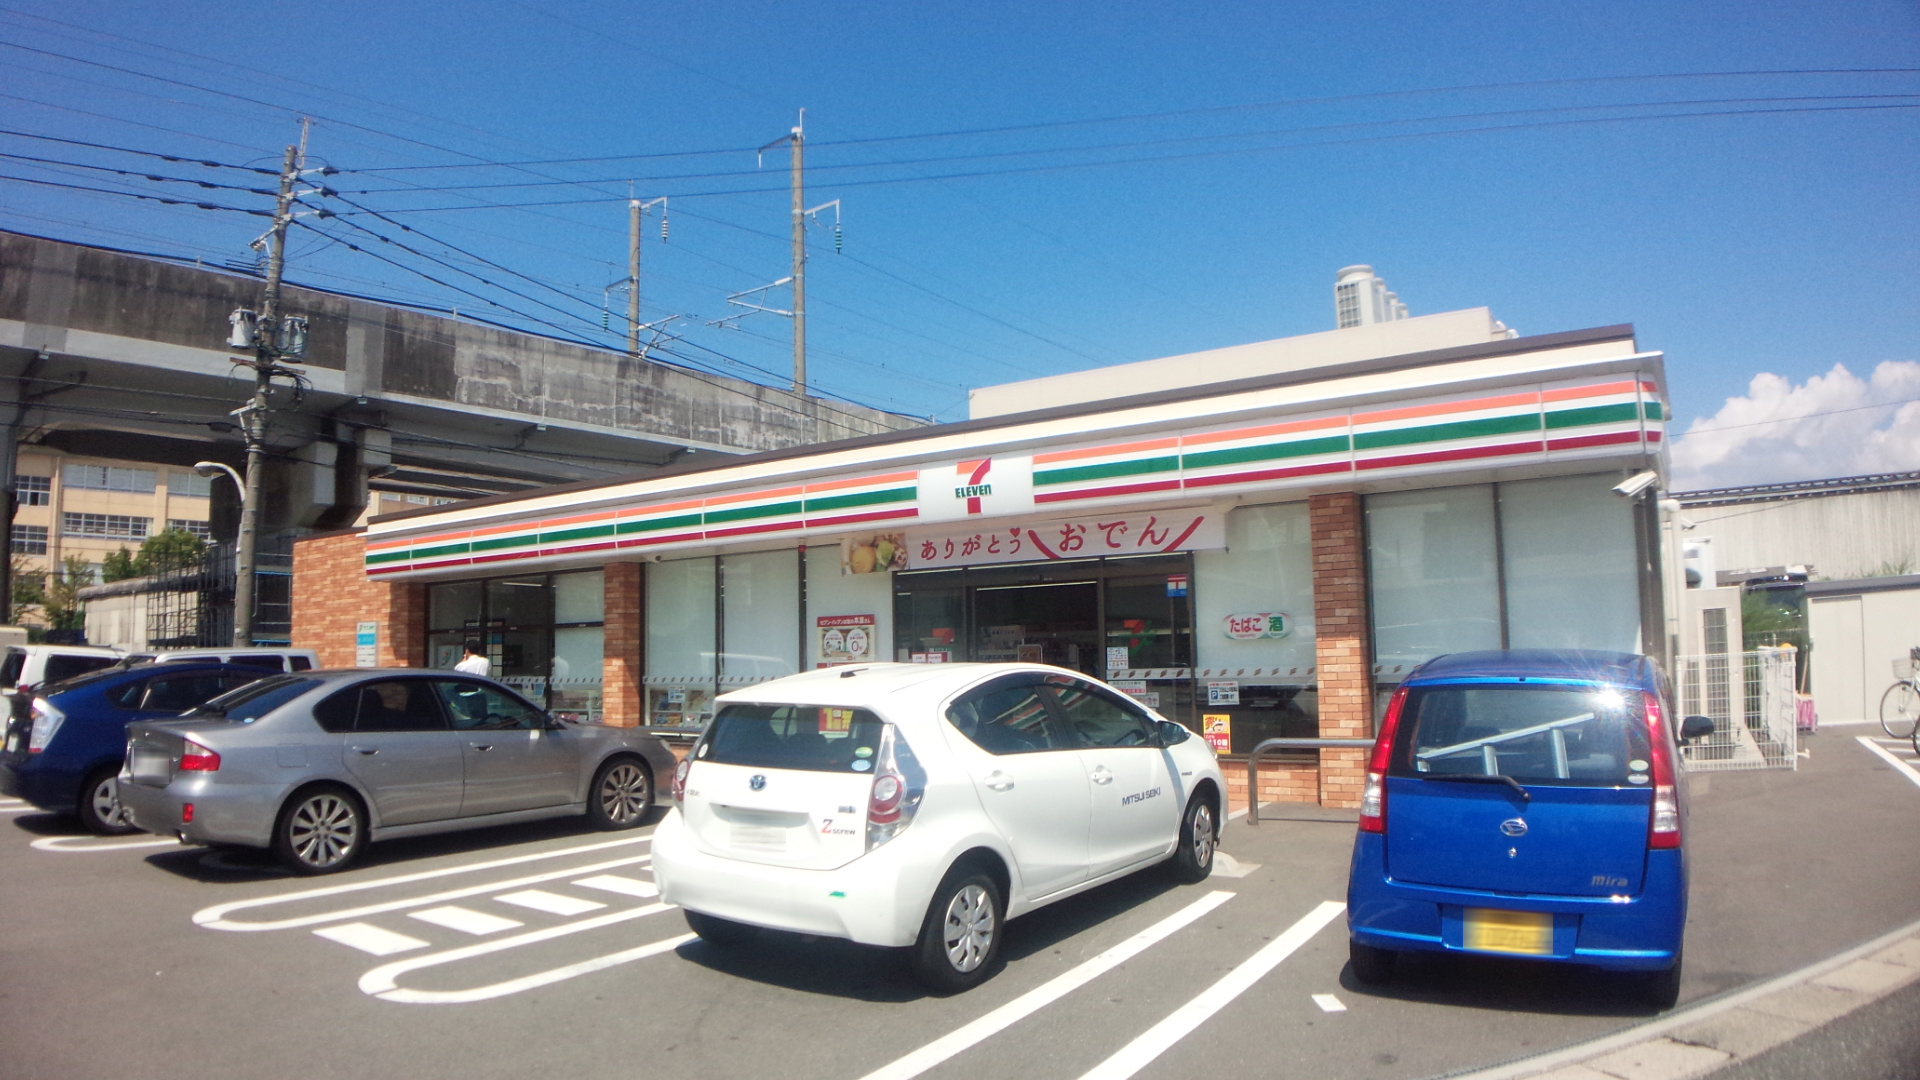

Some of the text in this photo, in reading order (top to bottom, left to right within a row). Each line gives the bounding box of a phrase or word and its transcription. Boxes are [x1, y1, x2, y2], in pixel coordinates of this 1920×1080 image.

[921, 516, 1169, 561] ありがとう おでん
[1230, 616, 1284, 633] たばこ 酒
